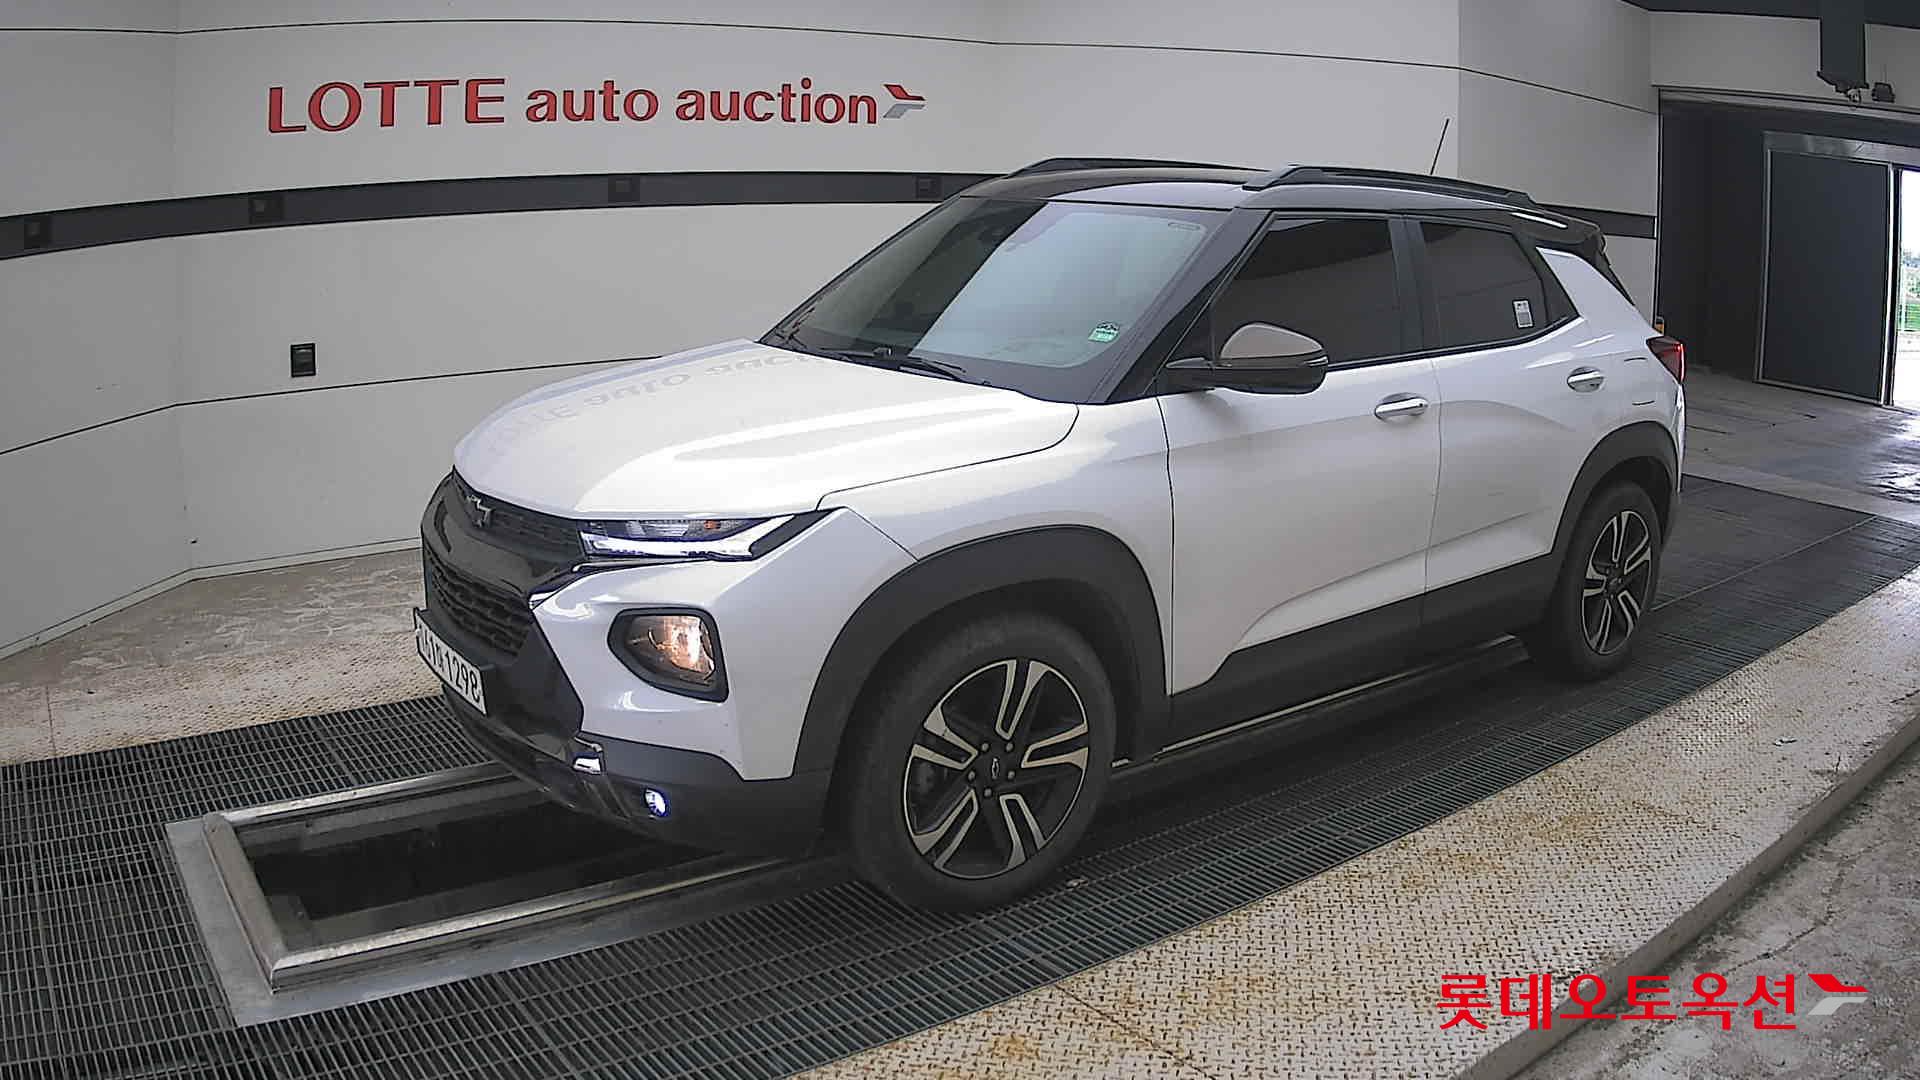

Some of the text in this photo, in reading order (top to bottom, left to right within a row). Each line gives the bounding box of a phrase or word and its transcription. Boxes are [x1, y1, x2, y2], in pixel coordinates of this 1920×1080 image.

[268, 77, 878, 134] LOTTE auto auction
